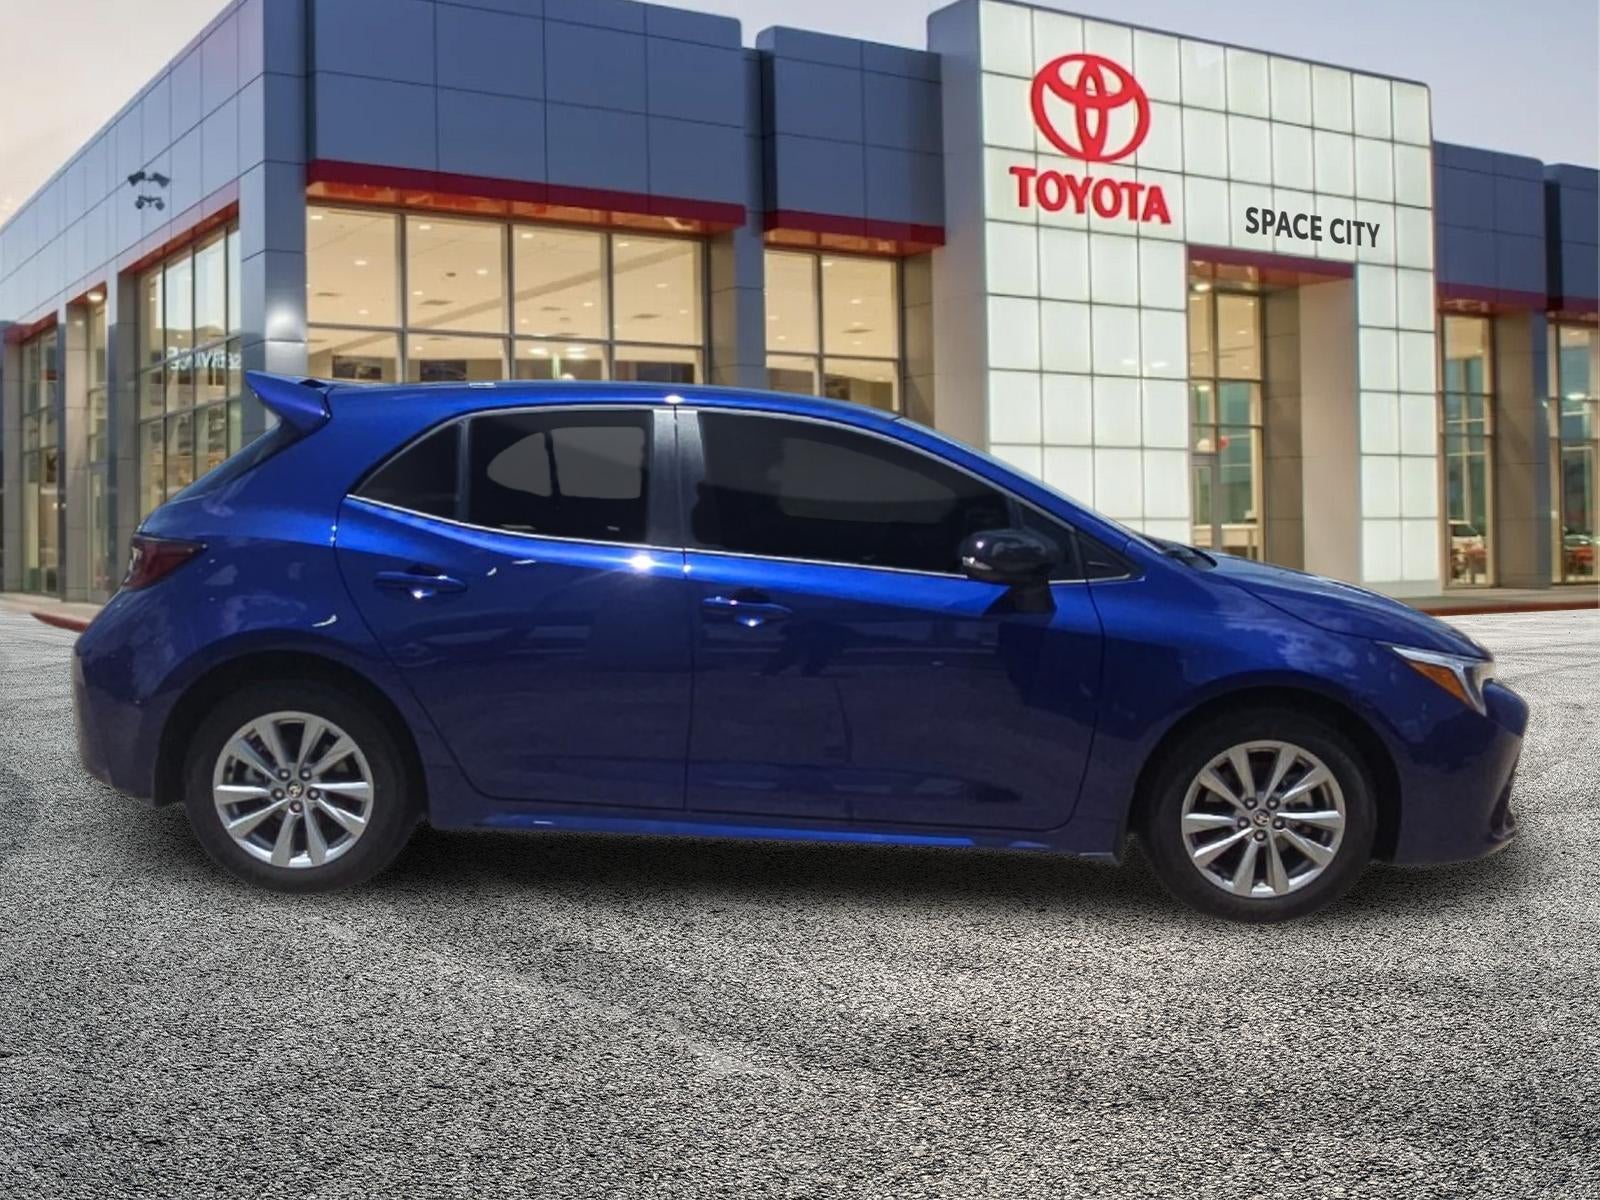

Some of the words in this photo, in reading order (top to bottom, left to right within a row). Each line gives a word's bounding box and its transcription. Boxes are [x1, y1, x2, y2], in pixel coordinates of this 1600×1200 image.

[1009, 167, 1171, 224] TOYOTA
[1245, 207, 1322, 241] SPACE
[1329, 218, 1381, 247] CITY
